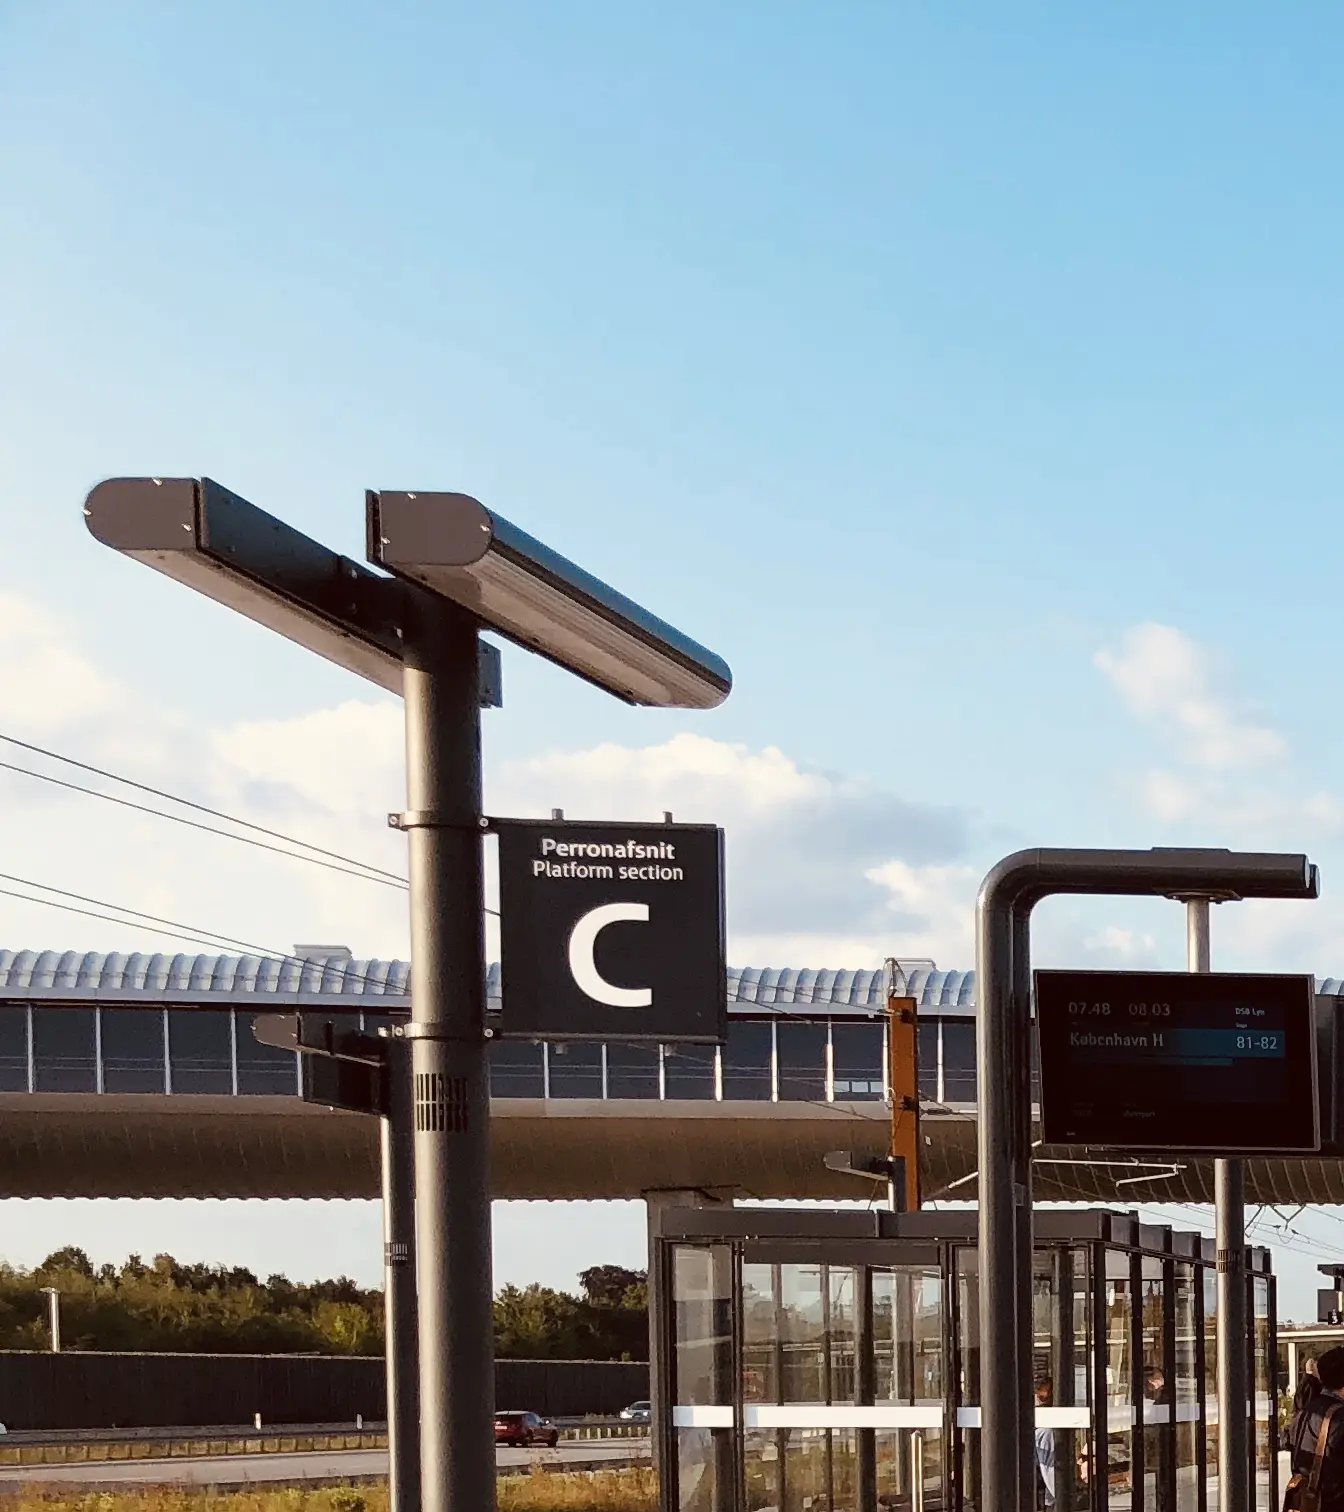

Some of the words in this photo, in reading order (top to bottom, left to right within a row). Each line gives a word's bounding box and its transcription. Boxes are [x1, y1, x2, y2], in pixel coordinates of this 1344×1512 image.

[541, 838, 676, 860] Perronafsnit
[533, 860, 614, 879] Platform
[619, 864, 684, 881] section
[568, 902, 653, 1008] C
[1068, 1002, 1111, 1016] 07.48
[1070, 1031, 1148, 1047] København
[1152, 1033, 1164, 1047] H
[1236, 1036, 1278, 1050] 81-82
